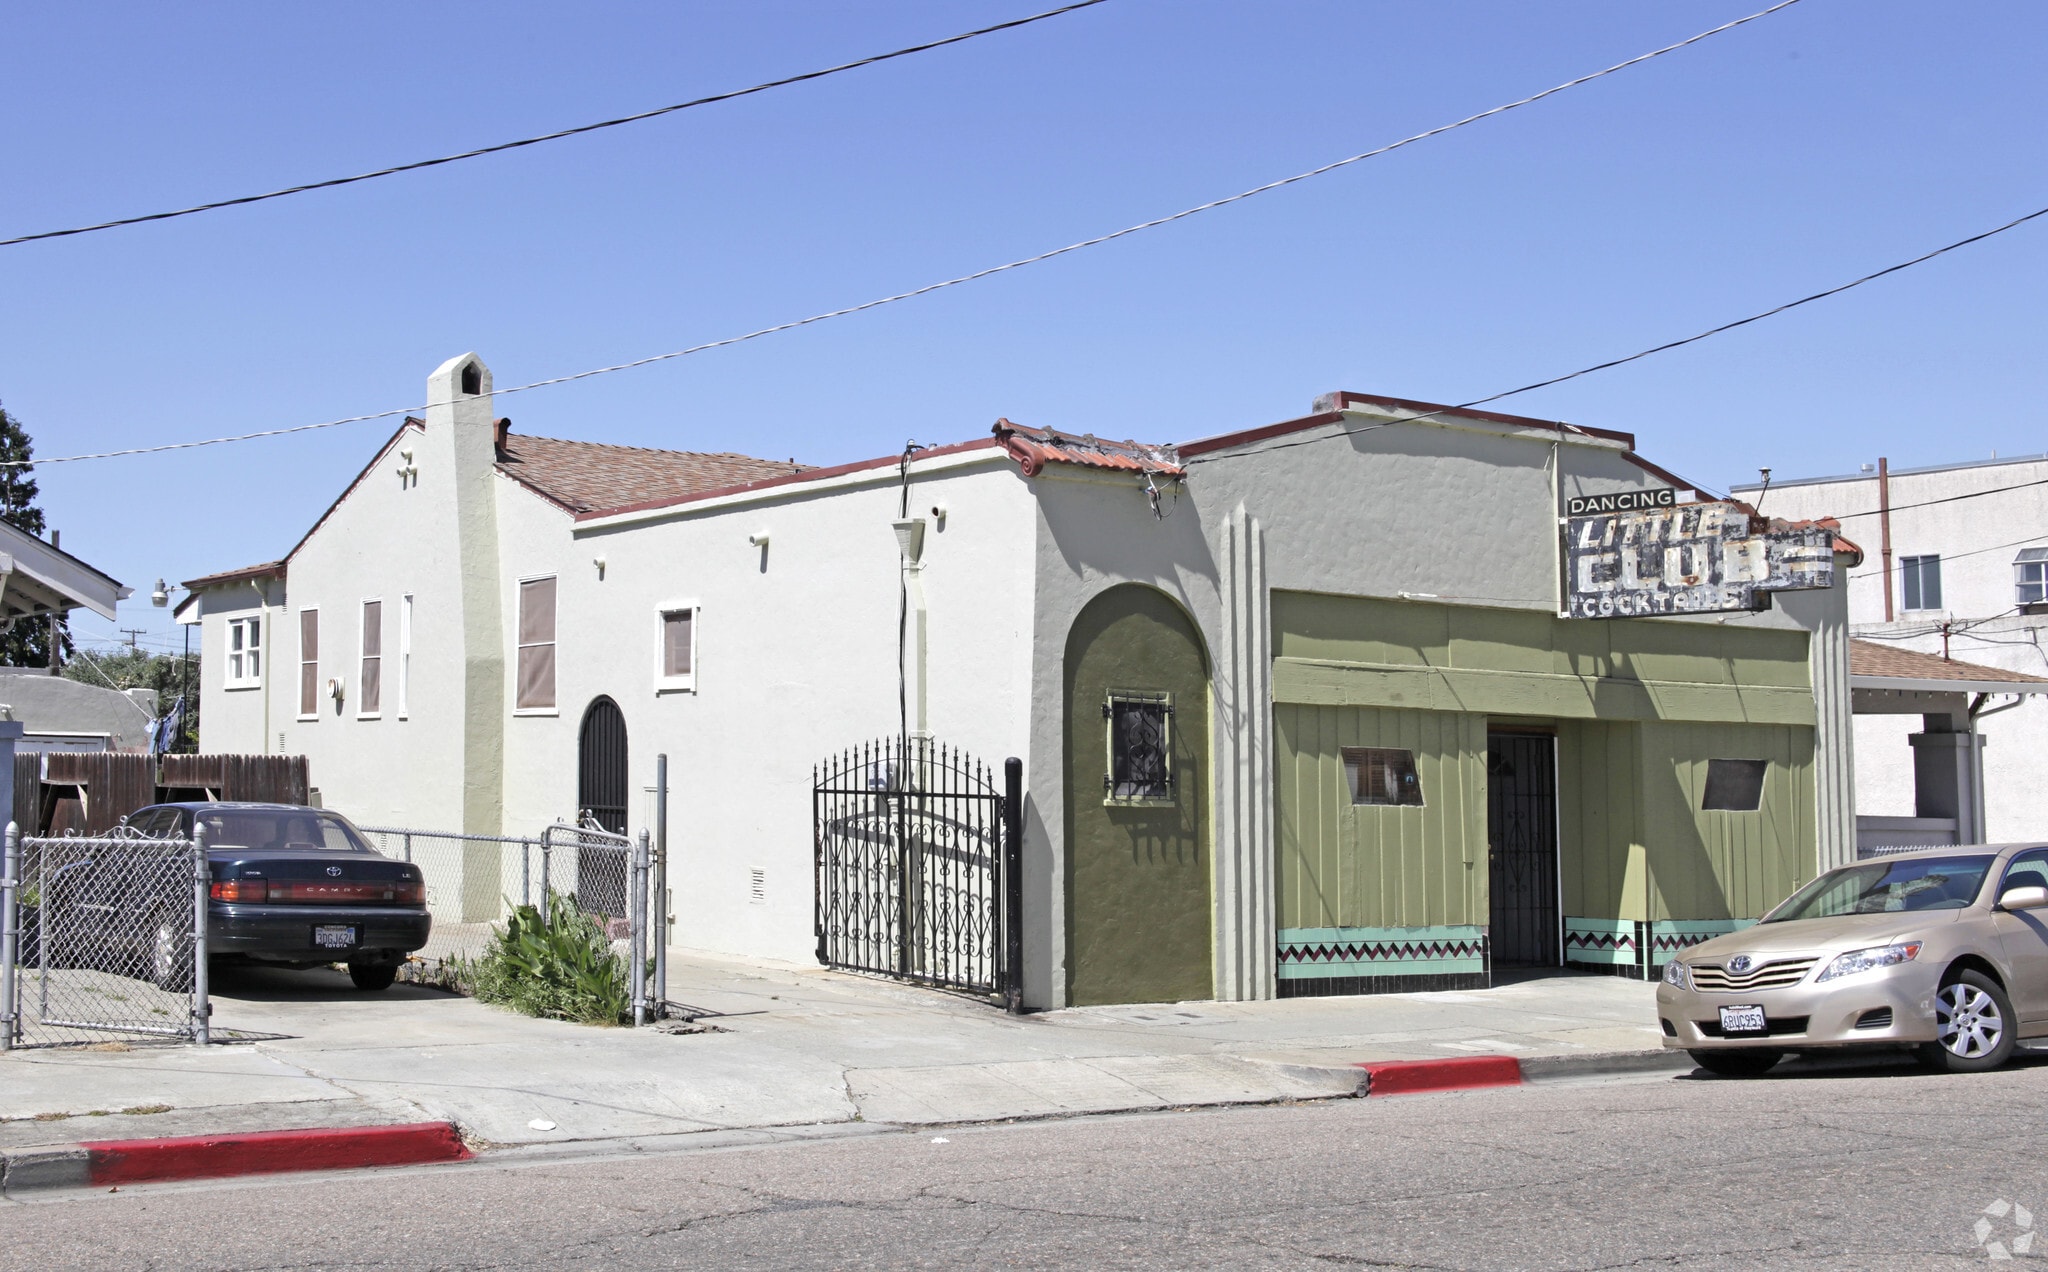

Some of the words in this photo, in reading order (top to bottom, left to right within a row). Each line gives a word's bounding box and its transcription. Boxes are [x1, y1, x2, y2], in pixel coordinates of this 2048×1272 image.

[1571, 490, 1672, 514] DANCING
[1578, 508, 1727, 549] LITTLE
[1577, 539, 1770, 593] CLUB
[1582, 588, 1740, 617] COCKTAILS
[317, 933, 354, 944] 3DGJ624
[1723, 1014, 1762, 1028] 6RUC953
